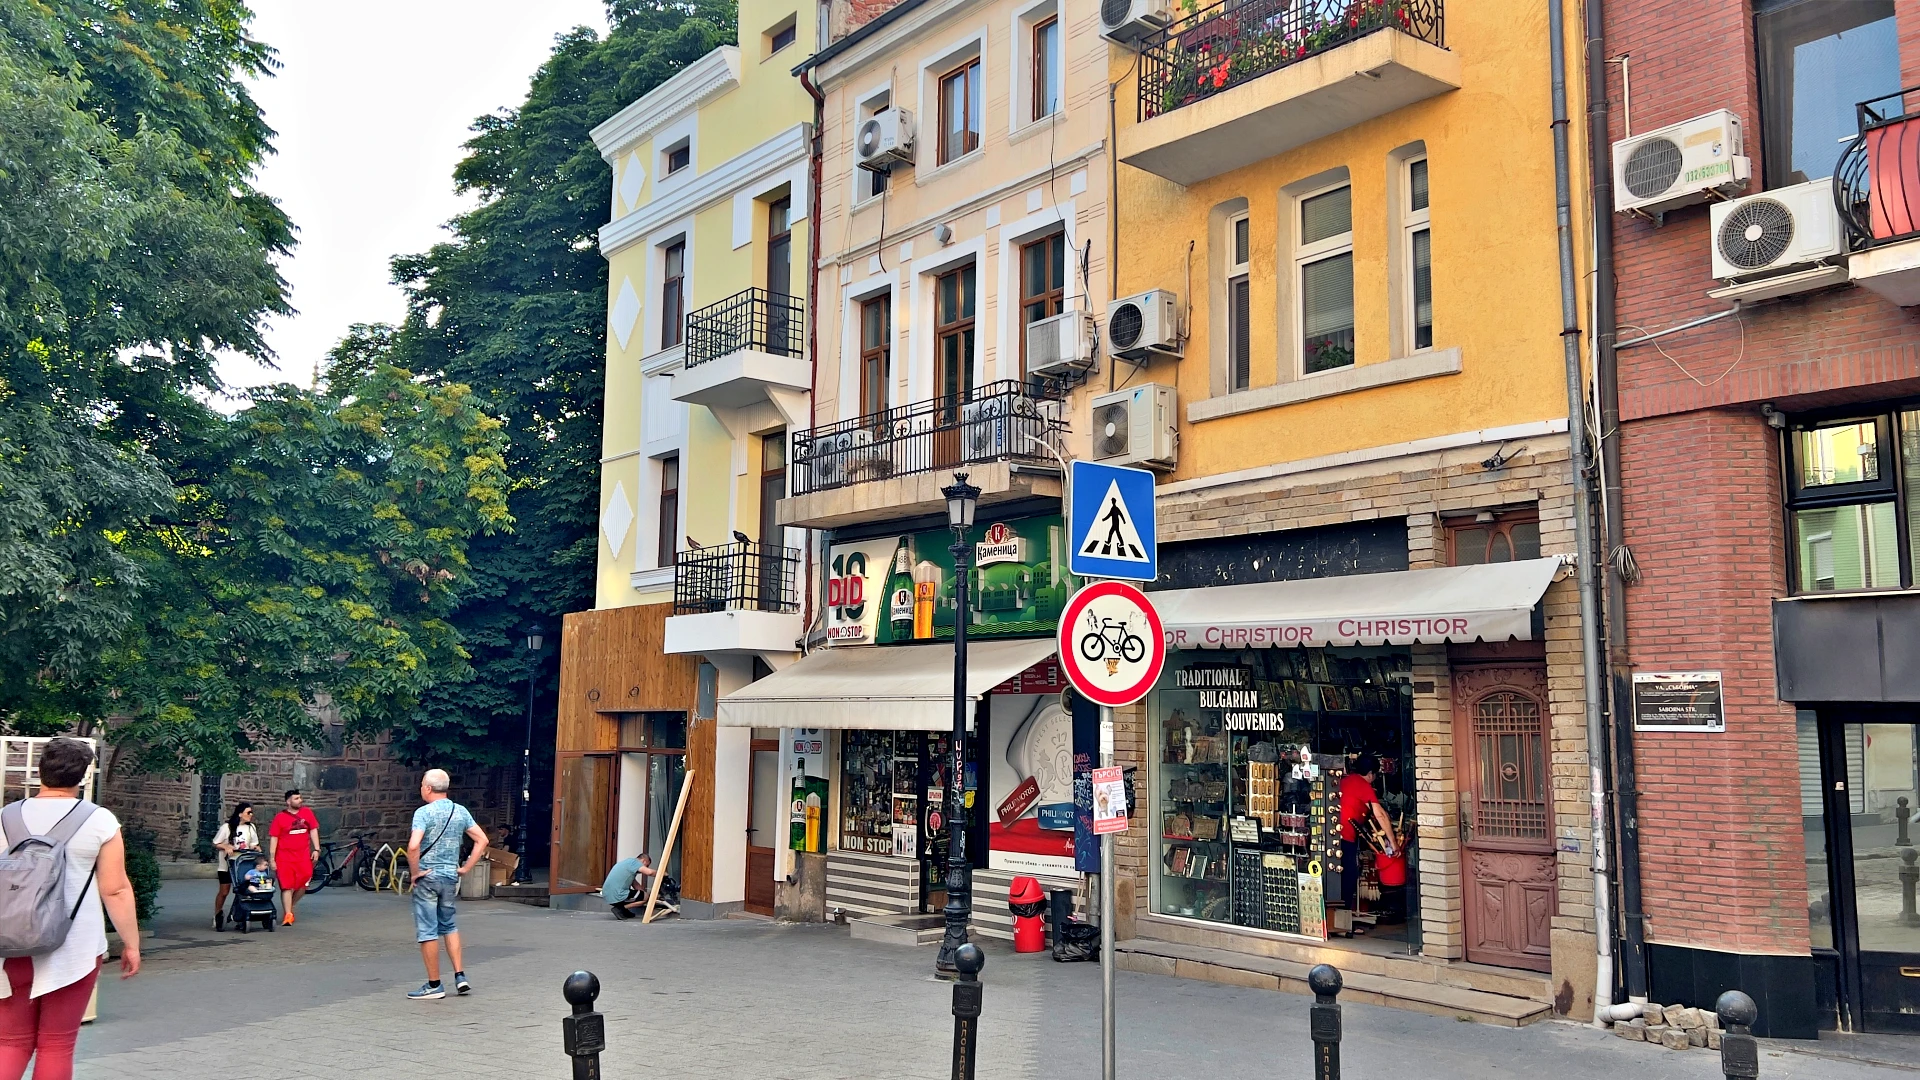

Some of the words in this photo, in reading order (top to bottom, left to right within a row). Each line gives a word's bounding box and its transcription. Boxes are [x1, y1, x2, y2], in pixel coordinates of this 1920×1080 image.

[977, 543, 1017, 561] Каменица
[827, 627, 840, 639] NON
[847, 625, 862, 638] STOP
[1205, 626, 1313, 644] CHRISTIOR
[1338, 618, 1468, 637] CHRISTIOR
[1175, 669, 1242, 687] TRADITIONAL
[1200, 690, 1258, 708] BULGARIAN
[1225, 712, 1284, 731] SOUVENIRS
[843, 835, 864, 853] NON
[867, 838, 893, 854] STOP
